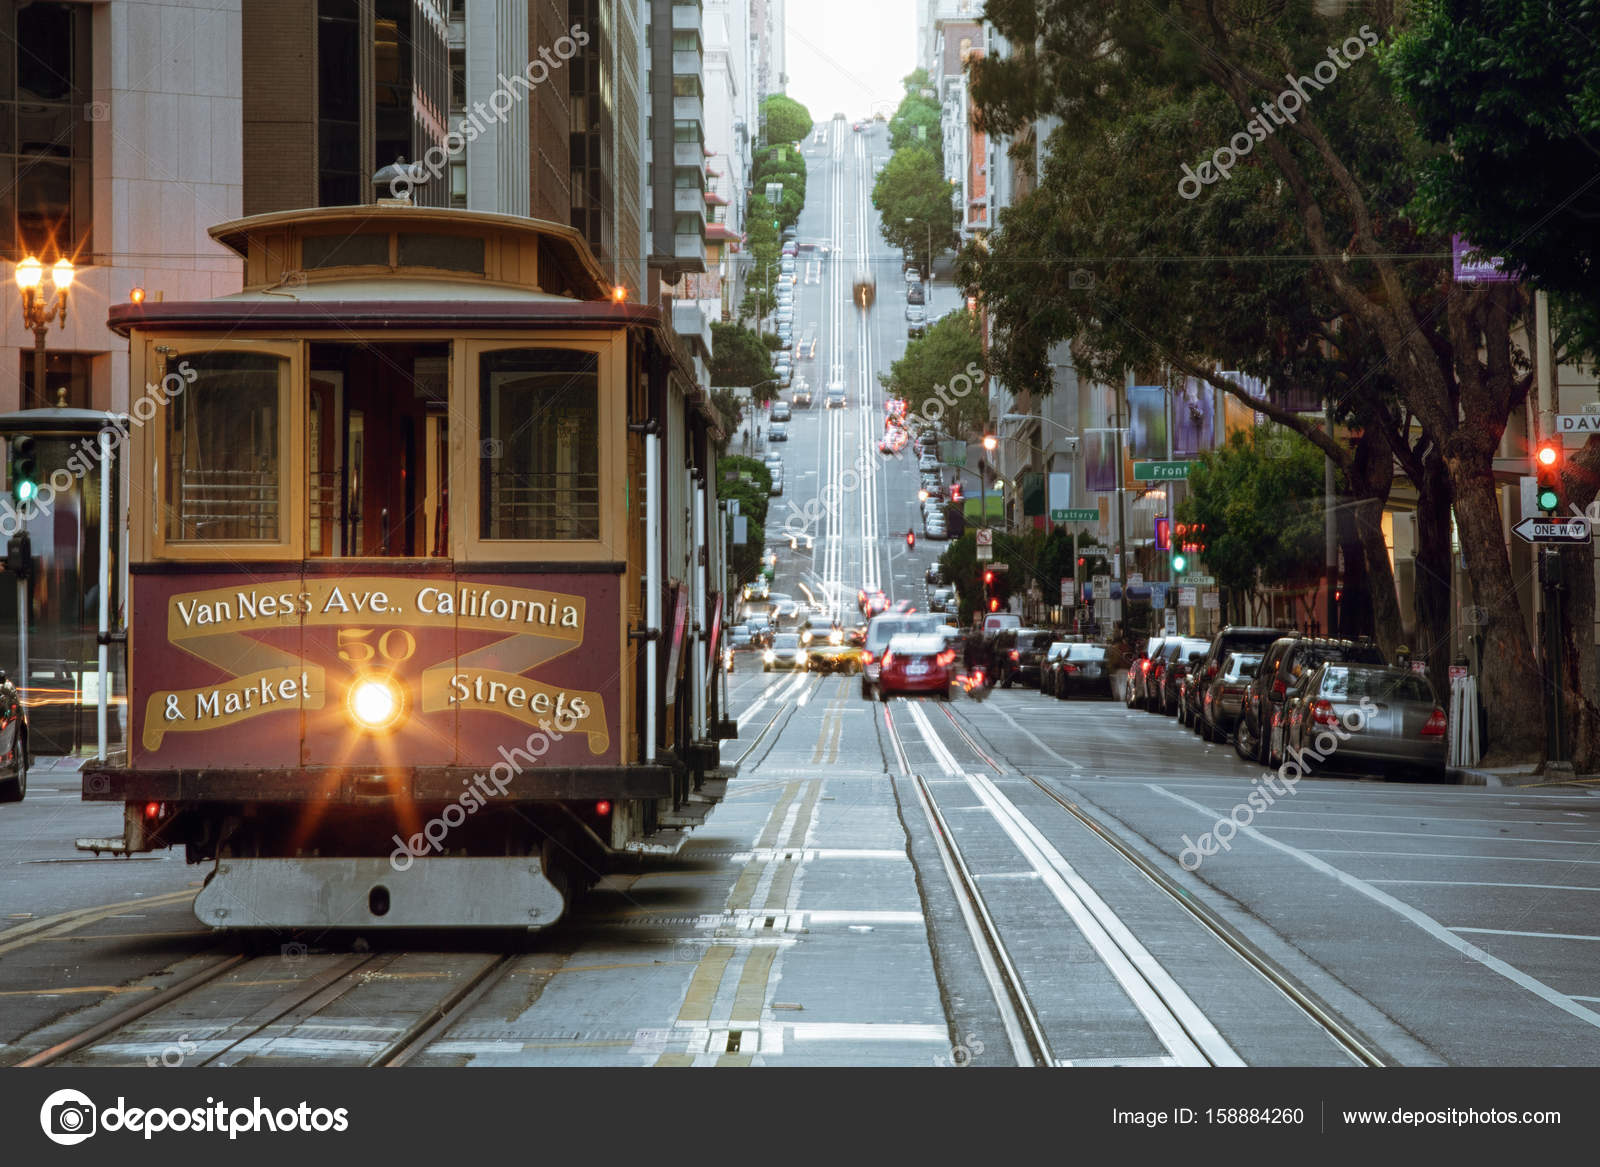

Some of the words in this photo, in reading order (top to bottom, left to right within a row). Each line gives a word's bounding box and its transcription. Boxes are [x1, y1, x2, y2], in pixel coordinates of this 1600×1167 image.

[1153, 466, 1188, 476] Front
[1057, 511, 1094, 520] Battery
[1534, 524, 1557, 535] ONE
[1559, 524, 1582, 535] WAY
[177, 599, 231, 627] Van
[236, 591, 313, 621] Ness
[416, 586, 579, 629] California
[336, 628, 417, 663] 50
[164, 693, 186, 721] &
[196, 671, 312, 719] Market
[449, 673, 587, 719] Streets
